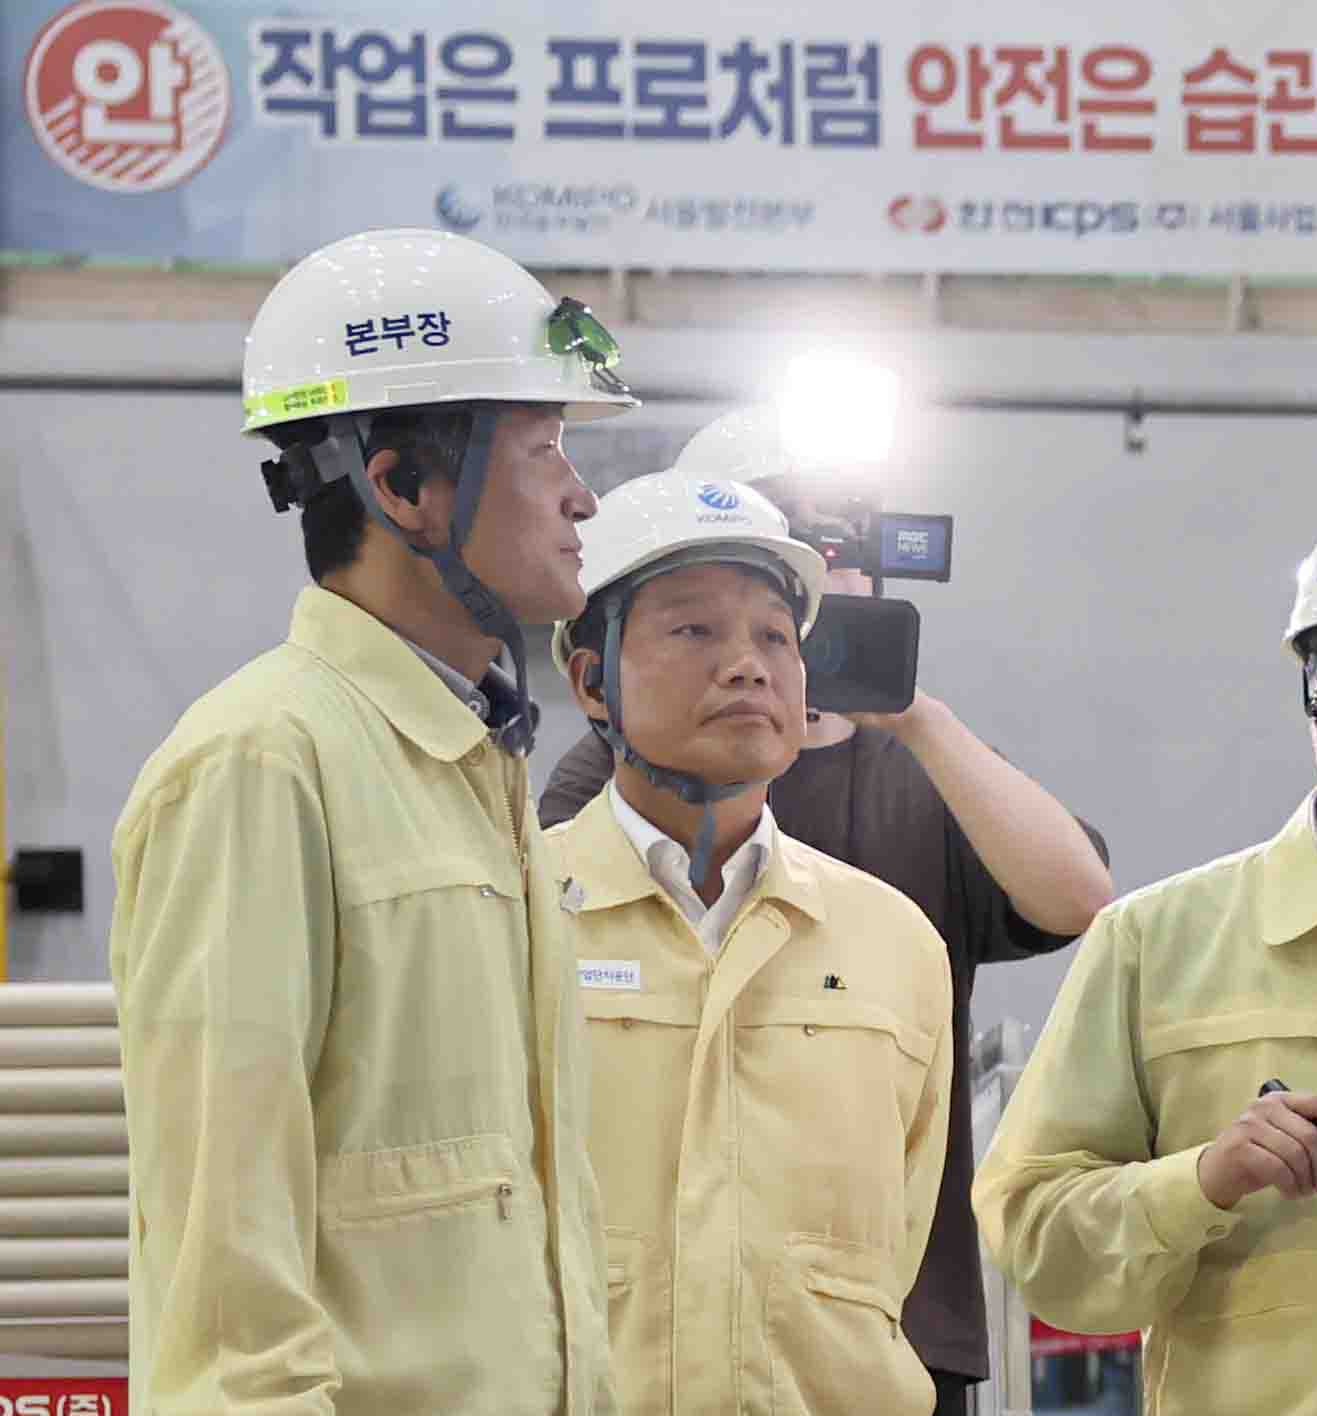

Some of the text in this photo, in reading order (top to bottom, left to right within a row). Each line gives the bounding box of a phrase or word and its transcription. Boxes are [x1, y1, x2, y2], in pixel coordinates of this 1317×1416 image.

[73, 38, 193, 147] 안
[257, 28, 516, 140] 작업은
[545, 38, 883, 148] 프로처럼
[906, 43, 1156, 153] 안전은
[345, 311, 452, 356] 본부장
